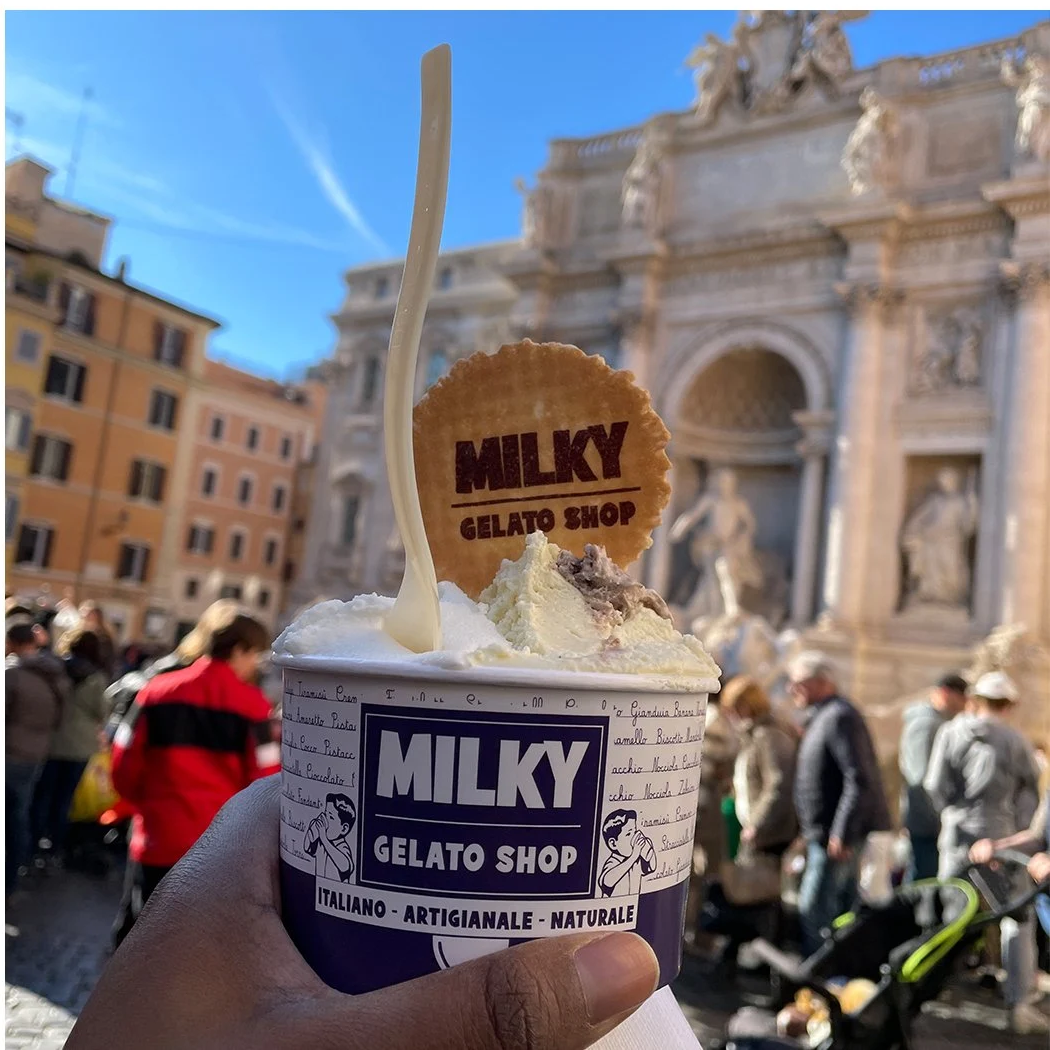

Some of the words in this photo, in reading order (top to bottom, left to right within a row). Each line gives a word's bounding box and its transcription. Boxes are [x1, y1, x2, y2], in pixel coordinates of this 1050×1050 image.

[455, 420, 630, 494] MILKY
[460, 508, 555, 541] GELATO
[564, 501, 637, 530] SHOP
[631, 700, 670, 727] Gianduia
[307, 763, 345, 786] Cioccolato
[376, 730, 590, 809] MILKY
[644, 781, 673, 800] Nocciola
[374, 835, 485, 872] GELATO
[495, 845, 578, 874] SHOP
[318, 887, 386, 919] ITALIANO
[403, 905, 533, 930] ARTIGIANALE
[550, 905, 635, 930] NATURALE
